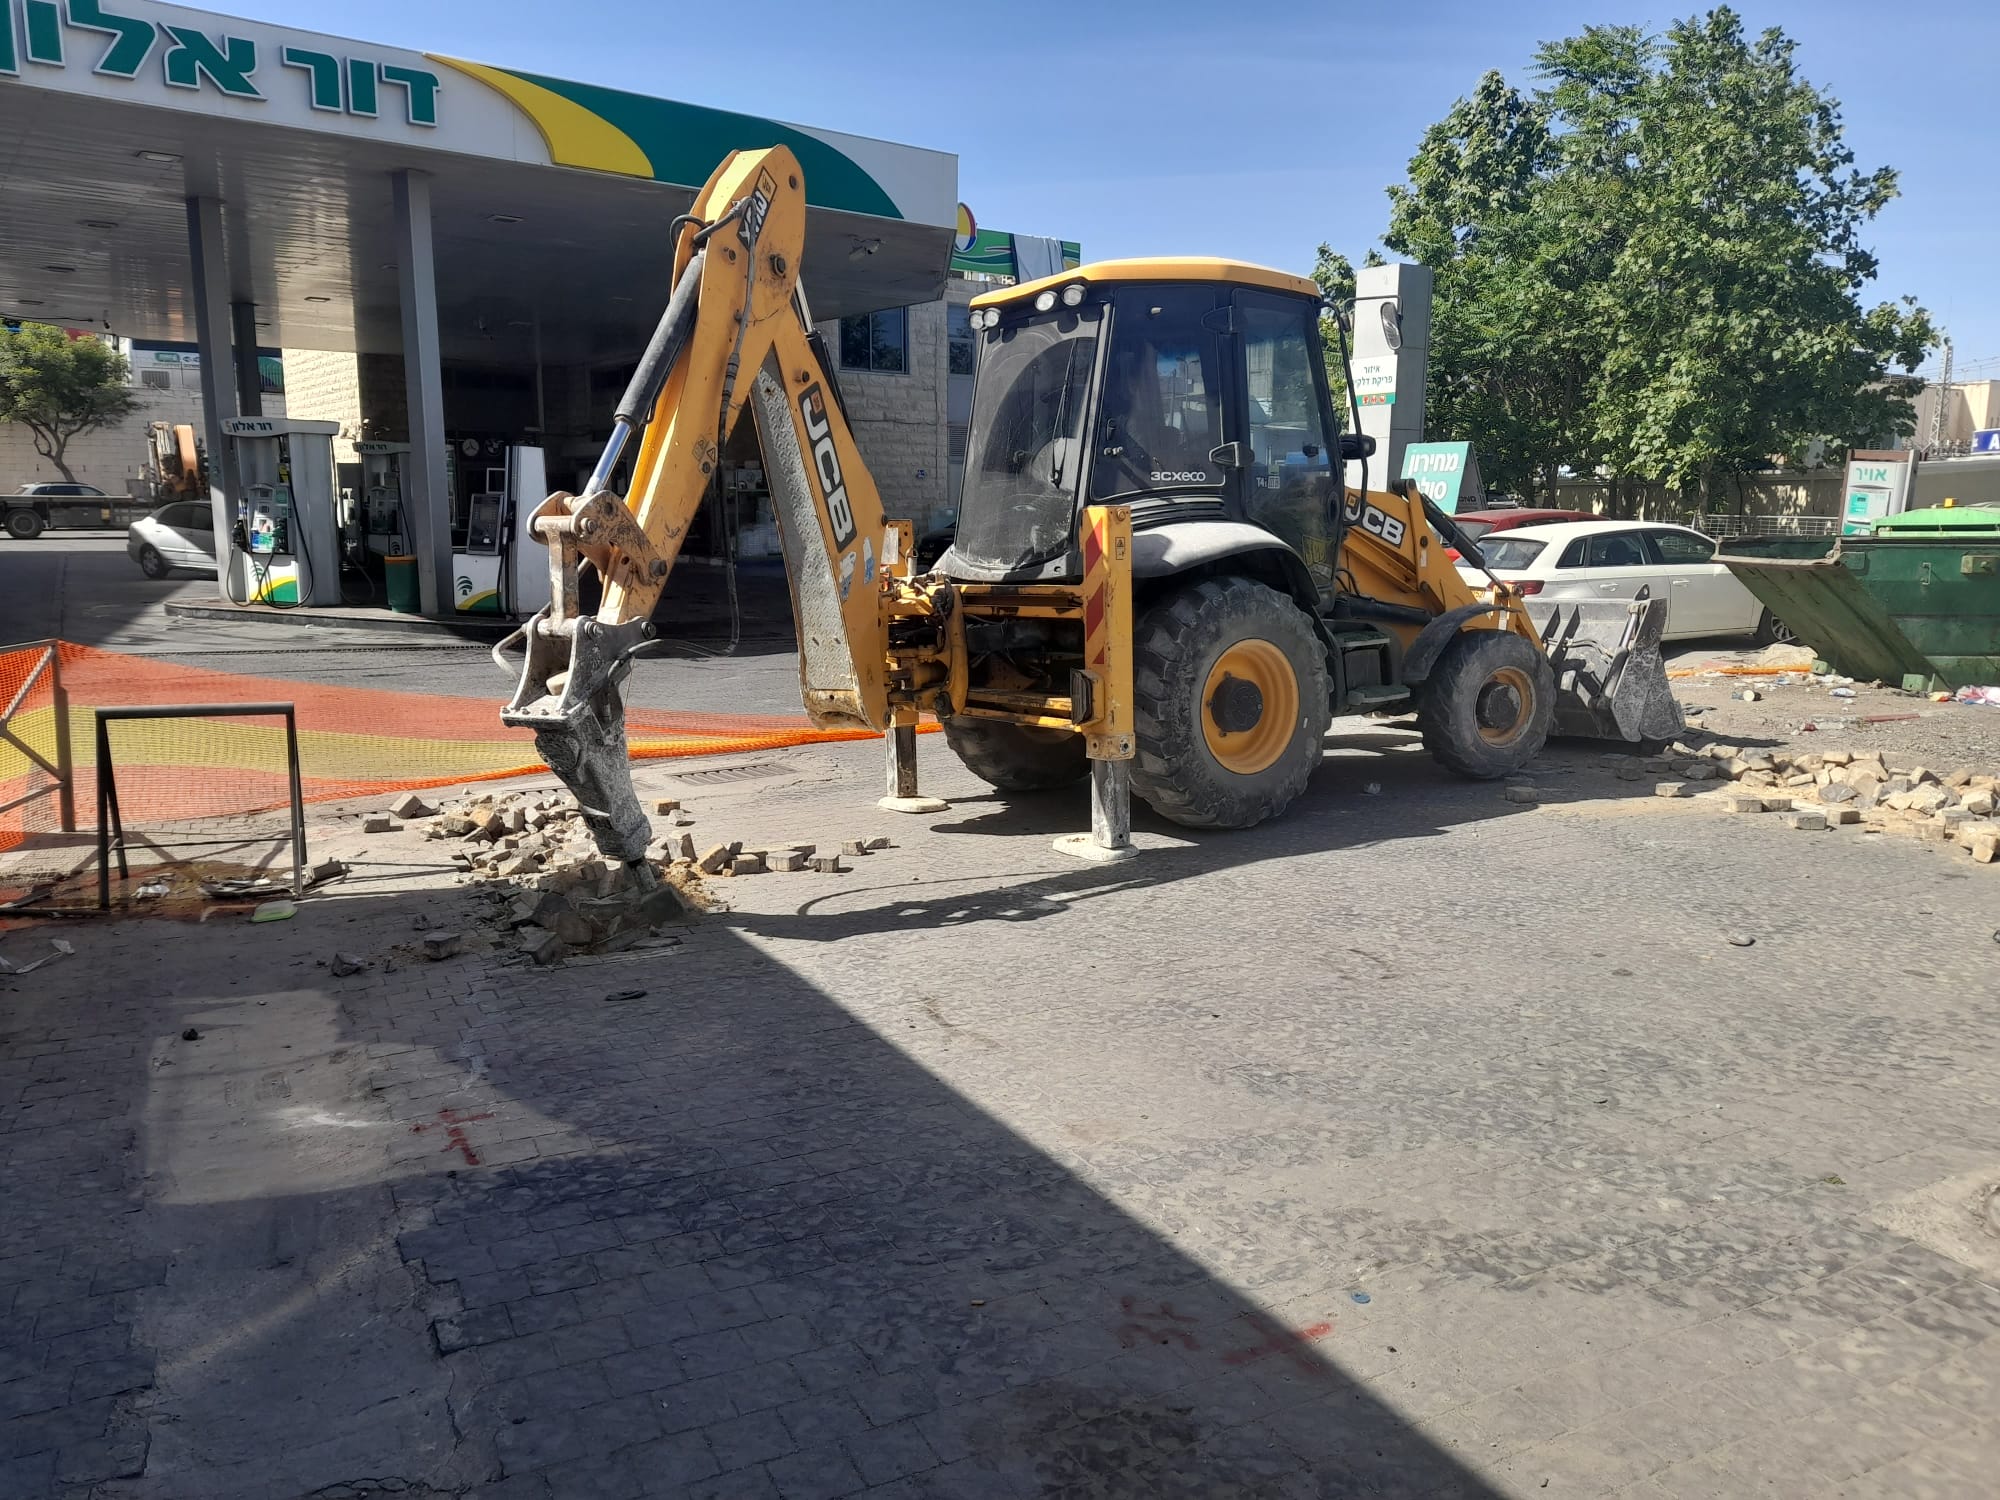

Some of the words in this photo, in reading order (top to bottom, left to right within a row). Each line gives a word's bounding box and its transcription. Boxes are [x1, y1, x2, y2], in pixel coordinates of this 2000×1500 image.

[281, 44, 440, 127] דור
[1363, 365, 1381, 374] איזור
[1372, 375, 1393, 387] פריקת
[231, 420, 256, 433] אלון
[256, 421, 273, 431] דור
[802, 396, 854, 544] JCB
[1408, 452, 1459, 476] מחירון
[1855, 467, 1888, 482] אויר
[1344, 501, 1405, 546] JCB
